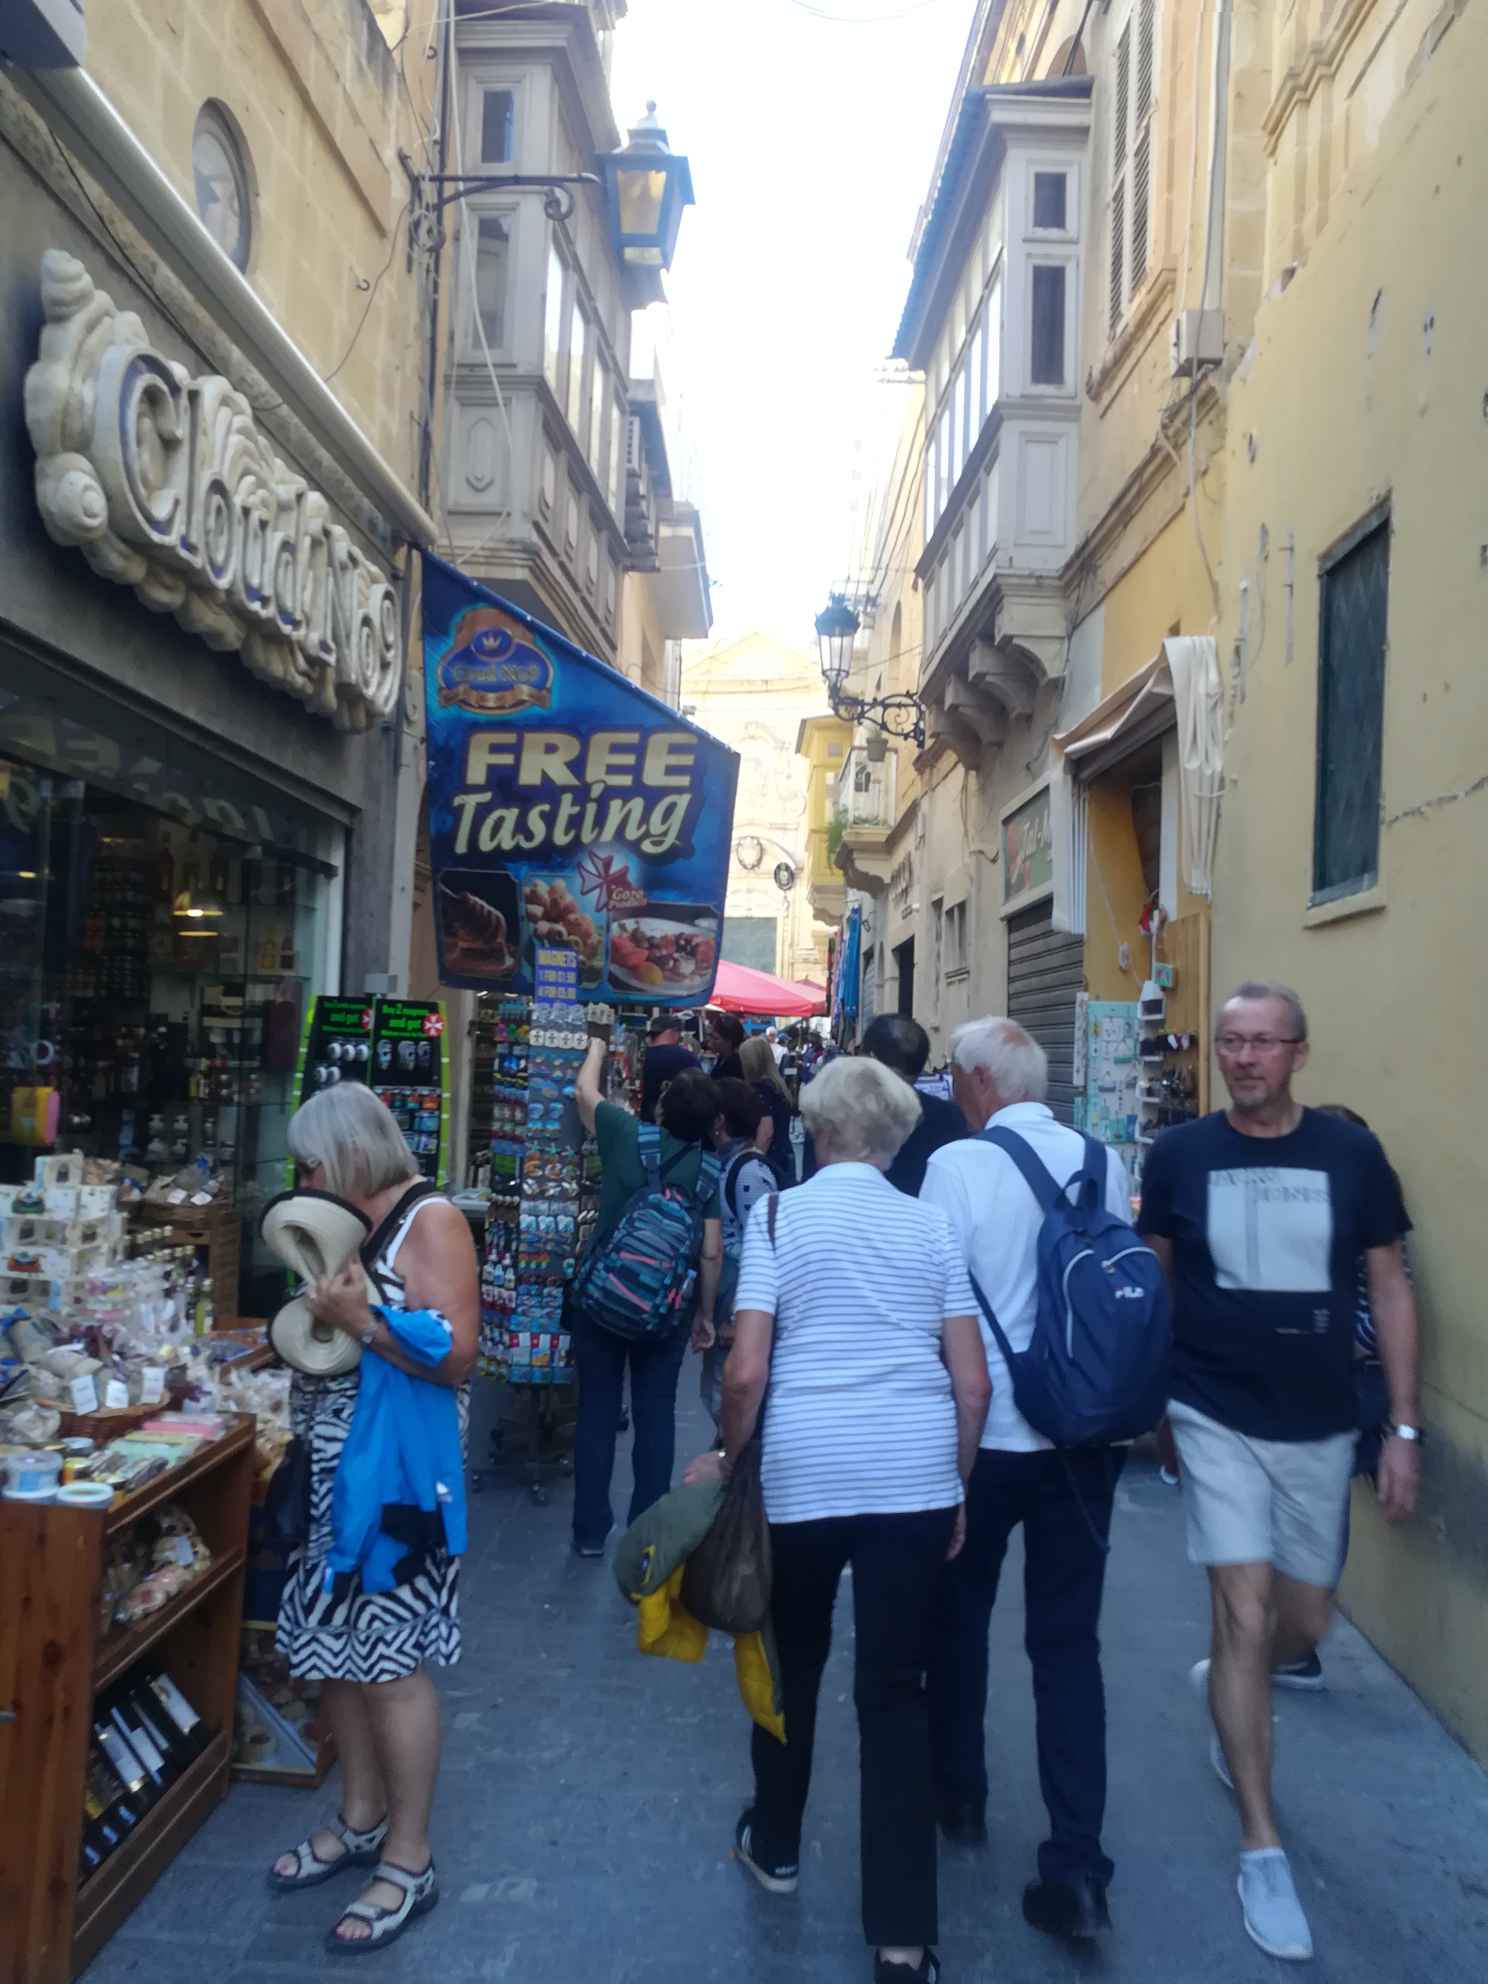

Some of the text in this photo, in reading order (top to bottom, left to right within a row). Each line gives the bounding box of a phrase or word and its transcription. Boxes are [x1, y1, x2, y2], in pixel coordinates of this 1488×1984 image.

[106, 343, 308, 640] Cloud
[465, 731, 698, 787] FREE
[452, 779, 692, 855] Tasting
